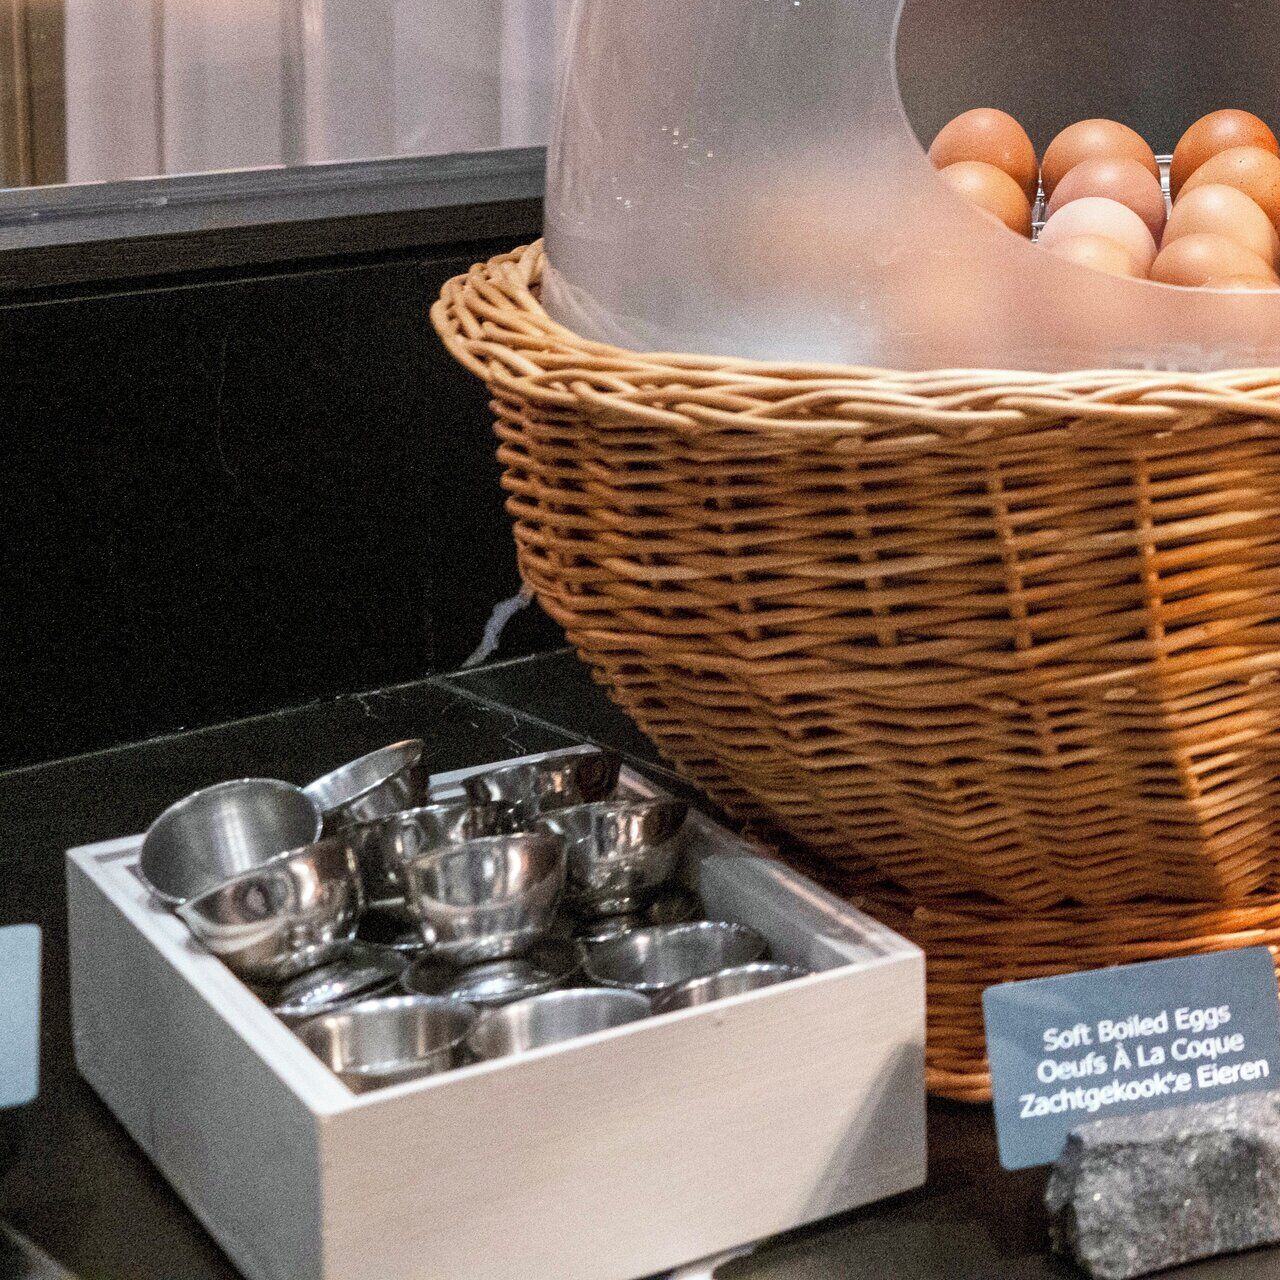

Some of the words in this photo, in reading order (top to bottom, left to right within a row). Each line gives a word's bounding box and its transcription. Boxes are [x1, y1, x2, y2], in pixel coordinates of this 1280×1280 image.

[1042, 1022, 1093, 1052] Soft
[1098, 1011, 1168, 1043] Boiled
[1174, 1005, 1232, 1034] Eggs
[1036, 1051, 1108, 1084] Oeufs
[1113, 1042, 1132, 1071] À
[1136, 1044, 1166, 1069] La
[1171, 1032, 1245, 1062] Coque
[1197, 1058, 1270, 1089] Eieren
